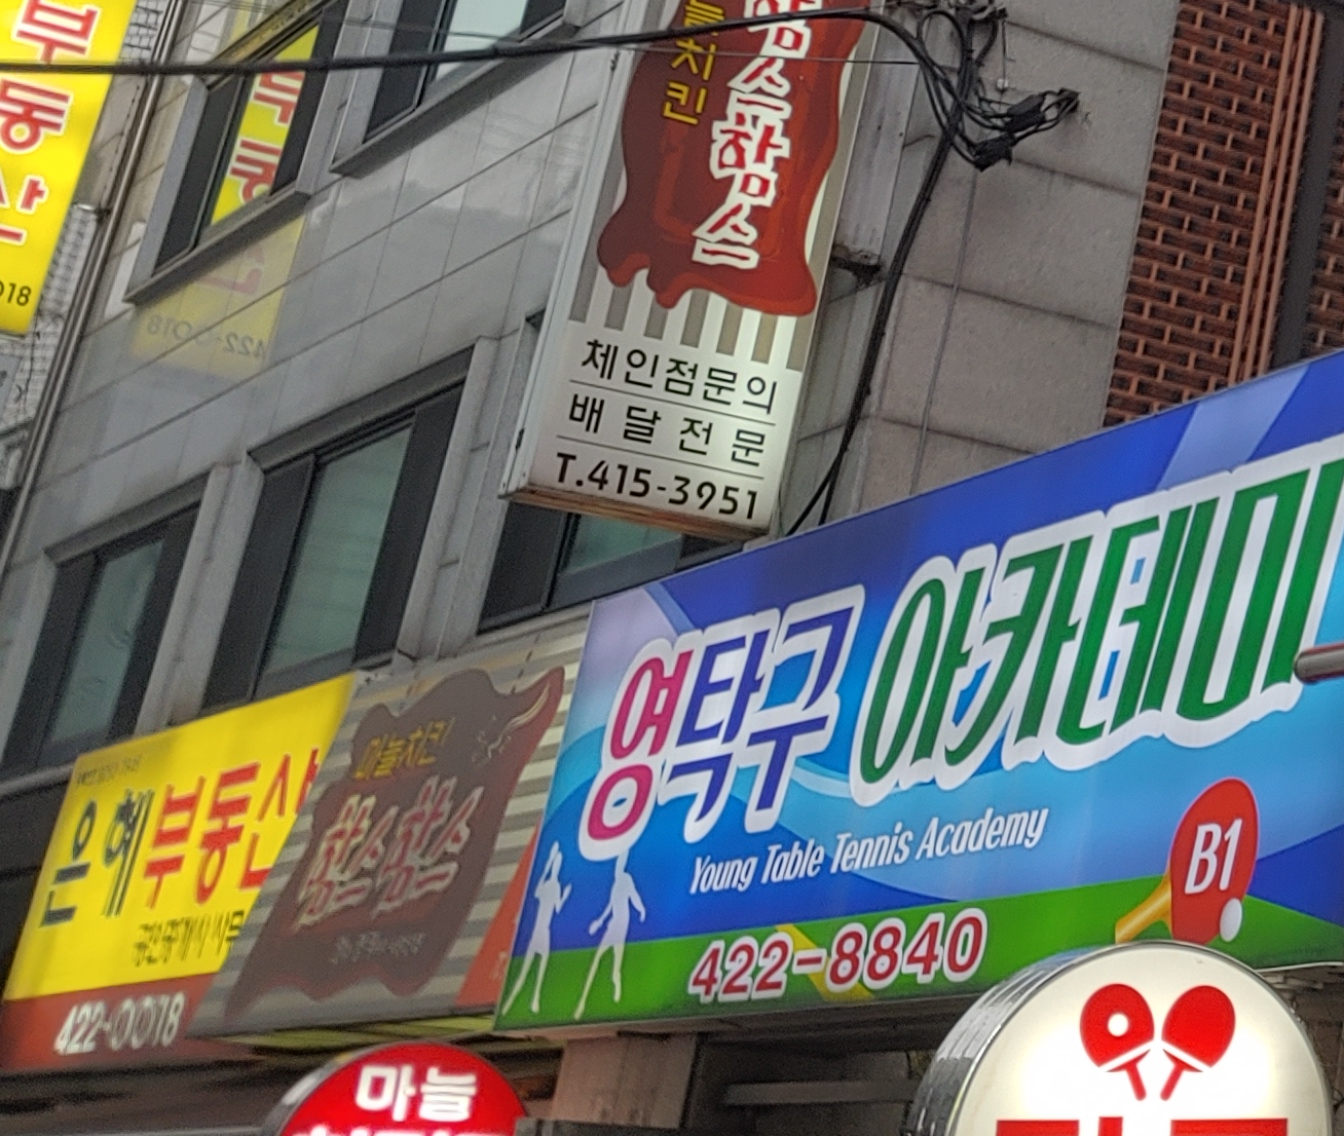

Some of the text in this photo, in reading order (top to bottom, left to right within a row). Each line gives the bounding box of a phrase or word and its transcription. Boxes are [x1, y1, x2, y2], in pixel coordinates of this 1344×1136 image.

[582, 339, 778, 415] 체인점문의
[569, 393, 767, 466] 배달전문
[556, 452, 759, 520] T.415-3951
[583, 602, 856, 844] 영탁구
[40, 788, 155, 928] 은혜
[690, 807, 1049, 894] Young Table Tennis Academy
[1184, 818, 1243, 894] B1
[690, 909, 987, 1001] 422-8840
[355, 1065, 477, 1122] 마늘
